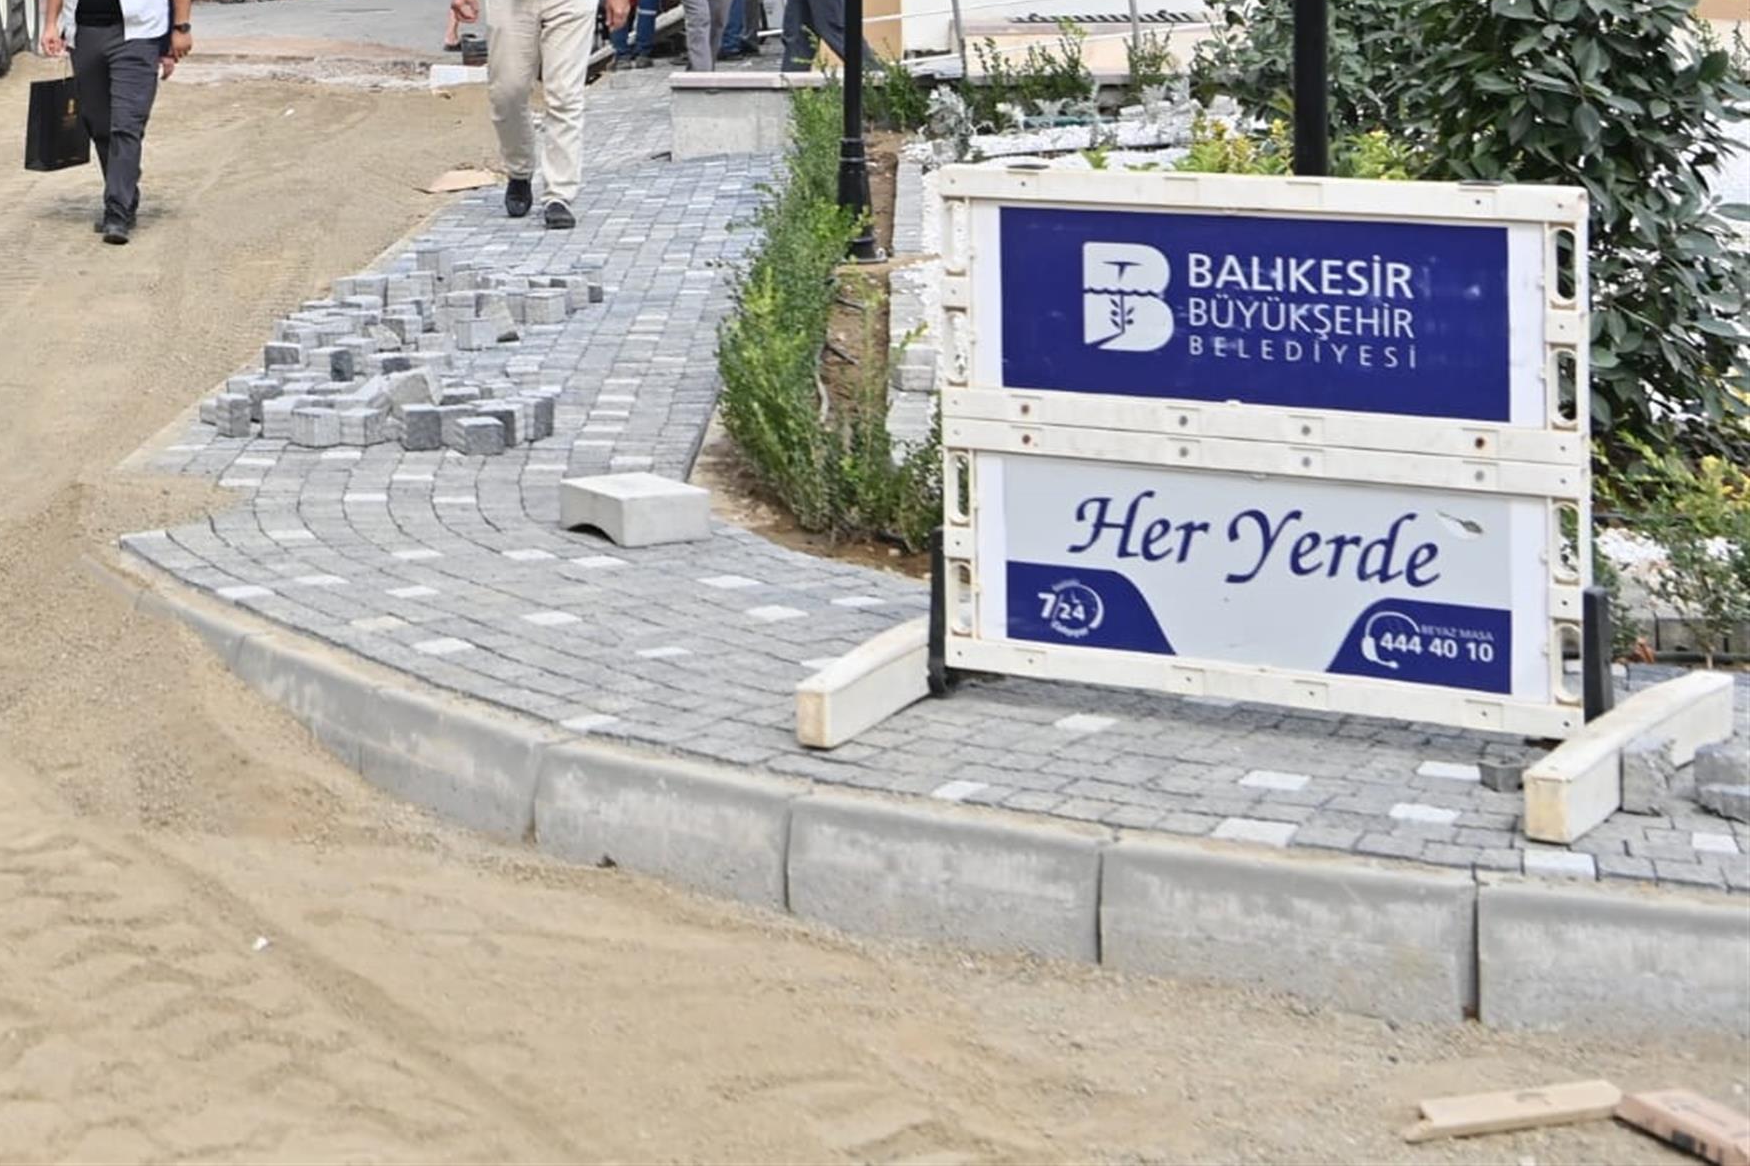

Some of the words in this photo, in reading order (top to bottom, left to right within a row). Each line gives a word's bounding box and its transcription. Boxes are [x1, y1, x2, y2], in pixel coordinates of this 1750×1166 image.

[1188, 251, 1414, 299] BALIKESİR
[1188, 294, 1414, 340] BÜYÜKŞEHİR
[1189, 335, 1416, 369] BELEDİYESİ
[1068, 489, 1209, 564] Her
[1225, 508, 1441, 589] Yerde
[1380, 631, 1423, 655] 444
[1428, 637, 1458, 659] 40
[1466, 642, 1494, 663] 10
[1420, 624, 1457, 638] BEYAZ
[1459, 628, 1494, 642] MASA
